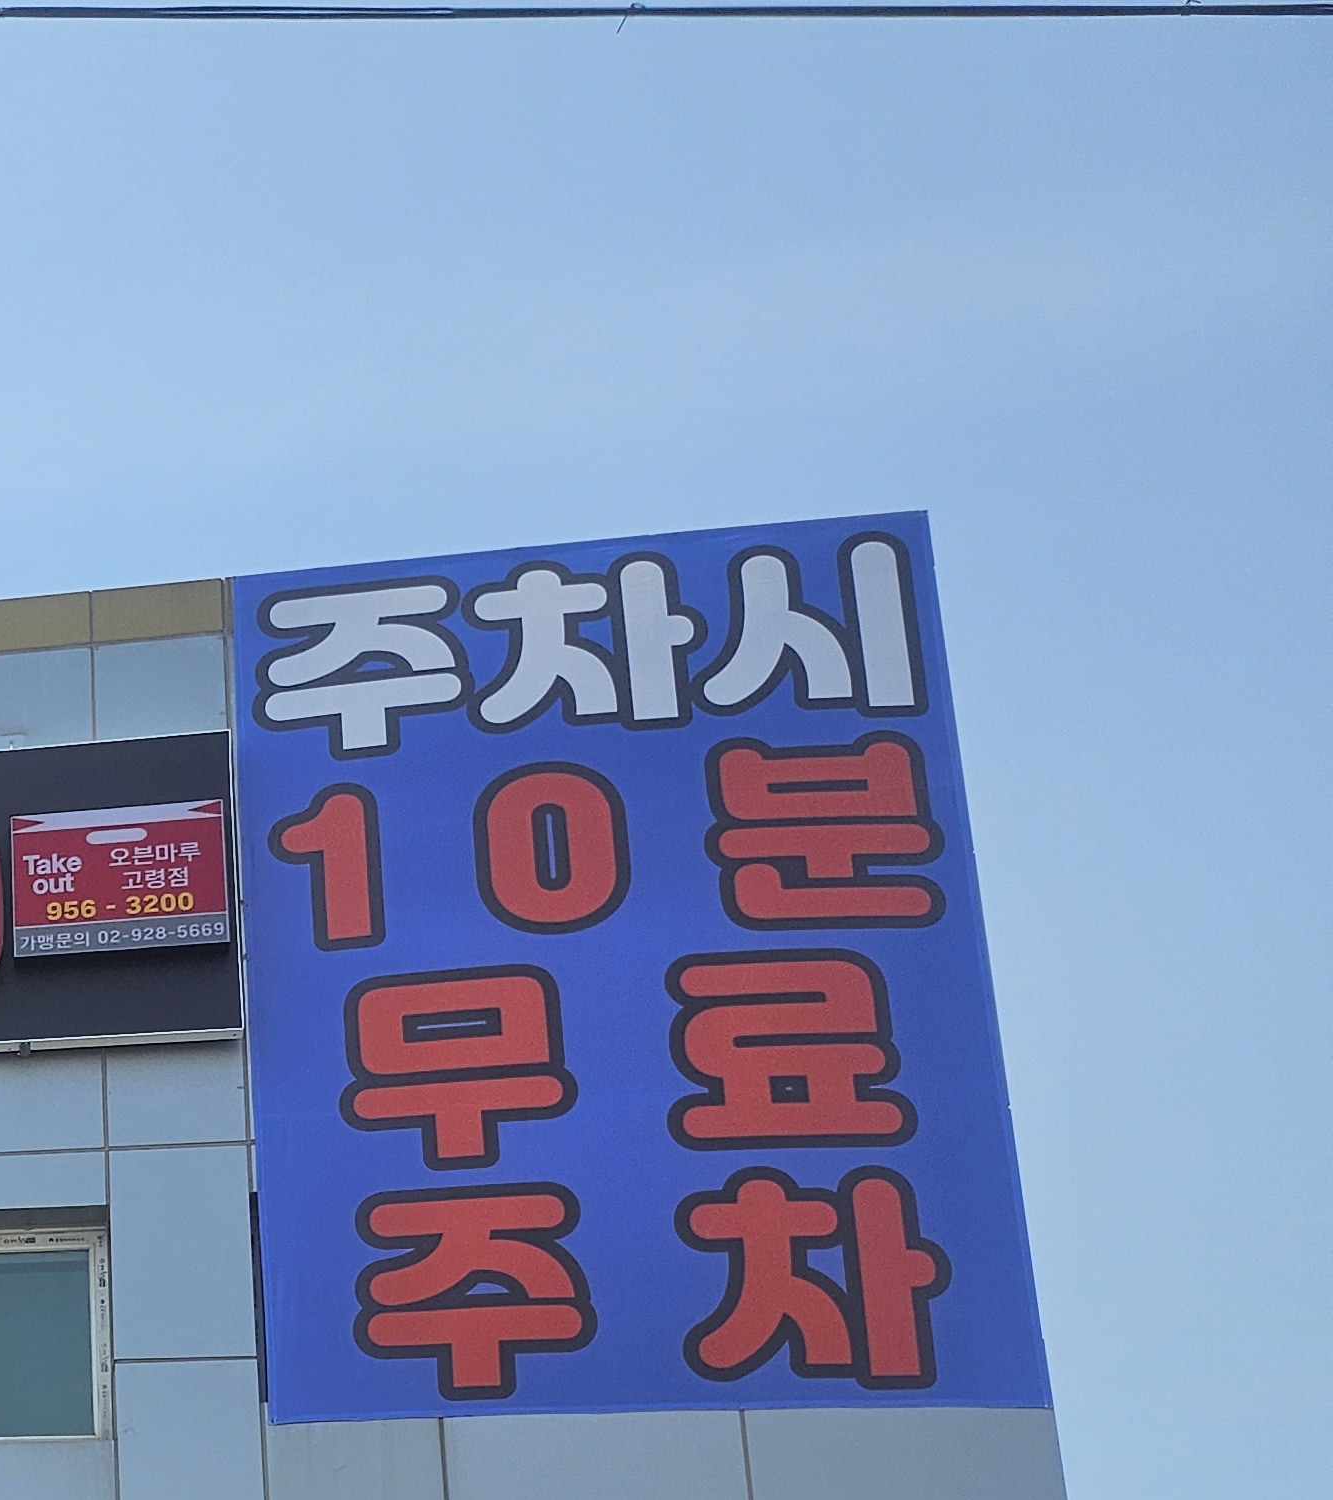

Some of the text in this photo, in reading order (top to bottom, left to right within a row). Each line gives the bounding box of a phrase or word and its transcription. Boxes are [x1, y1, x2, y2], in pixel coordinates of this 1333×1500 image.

[259, 536, 923, 755] 주차시
[22, 853, 82, 875] Take
[109, 841, 201, 867] 오븐마루
[32, 873, 75, 895] out
[121, 866, 189, 890] 고령점
[46, 891, 194, 921] 956 3200
[20, 922, 225, 951] 가맹문의 02-928-5669
[352, 957, 907, 1161] 무료
[365, 1176, 939, 1389] 주차
